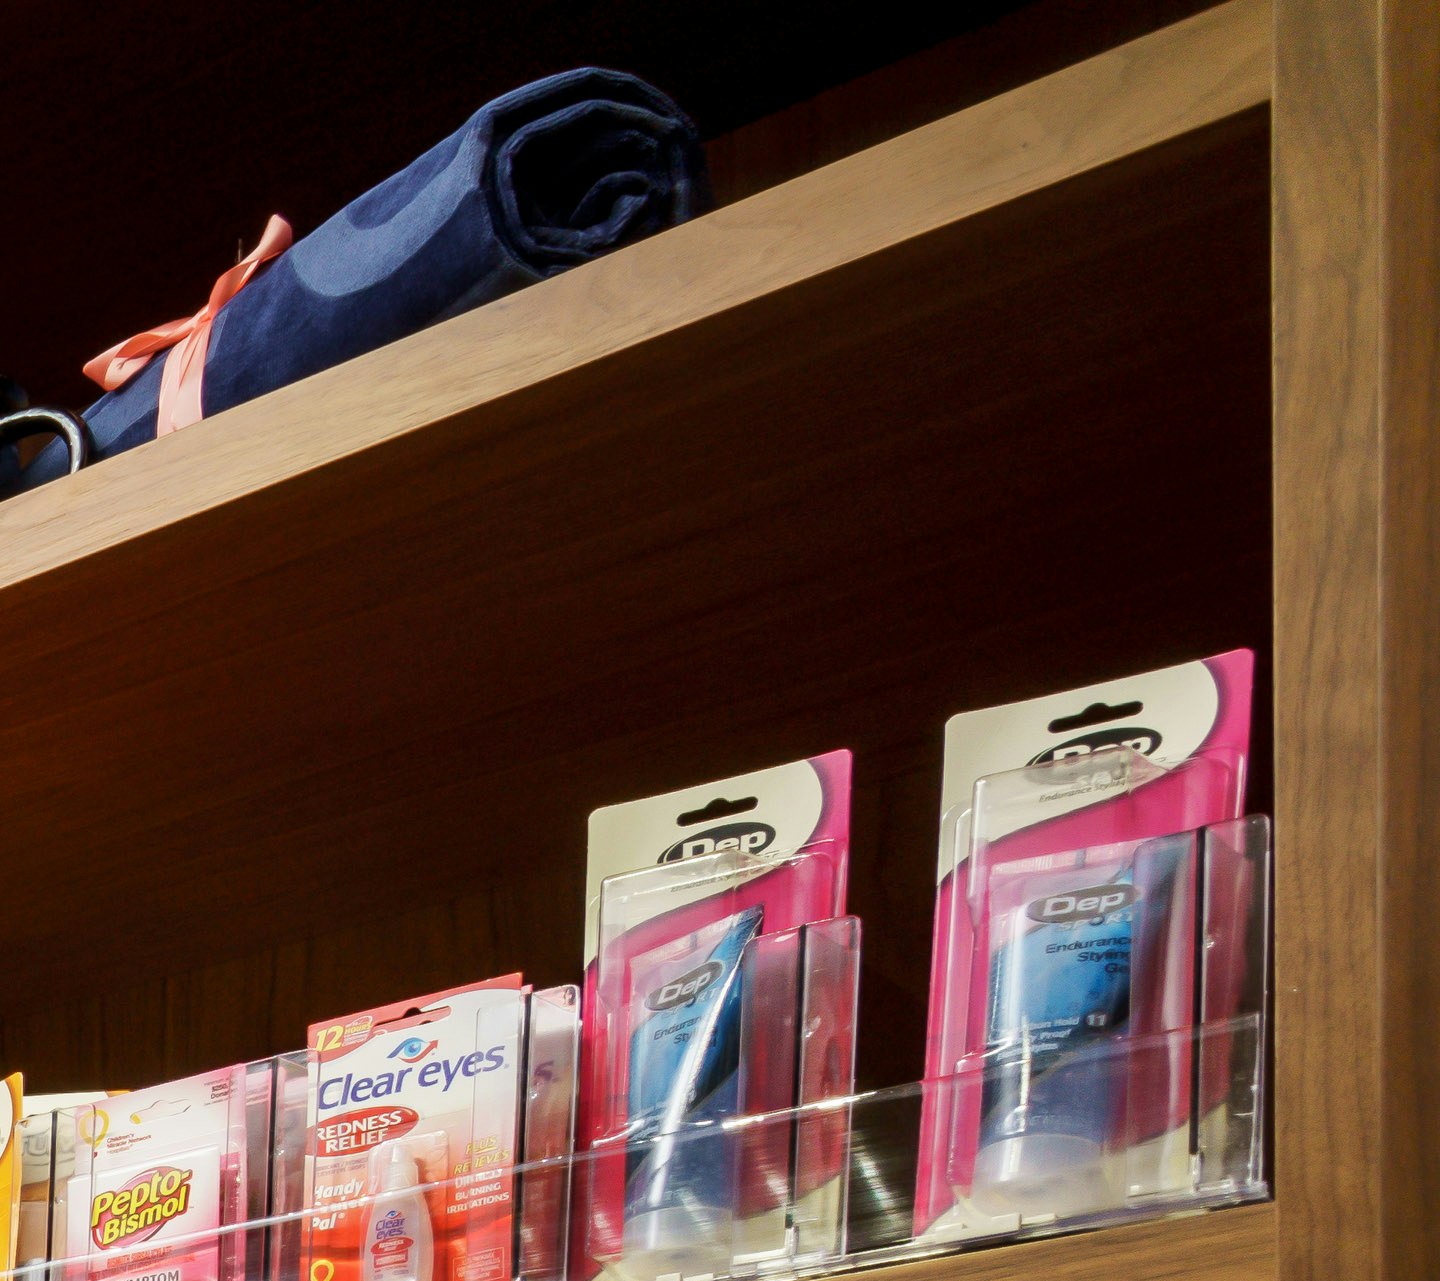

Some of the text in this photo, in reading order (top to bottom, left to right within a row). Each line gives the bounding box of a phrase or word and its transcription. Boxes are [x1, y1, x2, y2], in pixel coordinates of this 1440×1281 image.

[1043, 892, 1126, 916] Dep
[653, 971, 710, 1004] Dep
[316, 1025, 345, 1051] 12
[318, 1046, 505, 1110] Clear eyes
[326, 1129, 389, 1152] RELIEF
[91, 1168, 193, 1228] Pepto-
[102, 1184, 188, 1246] Bismol
